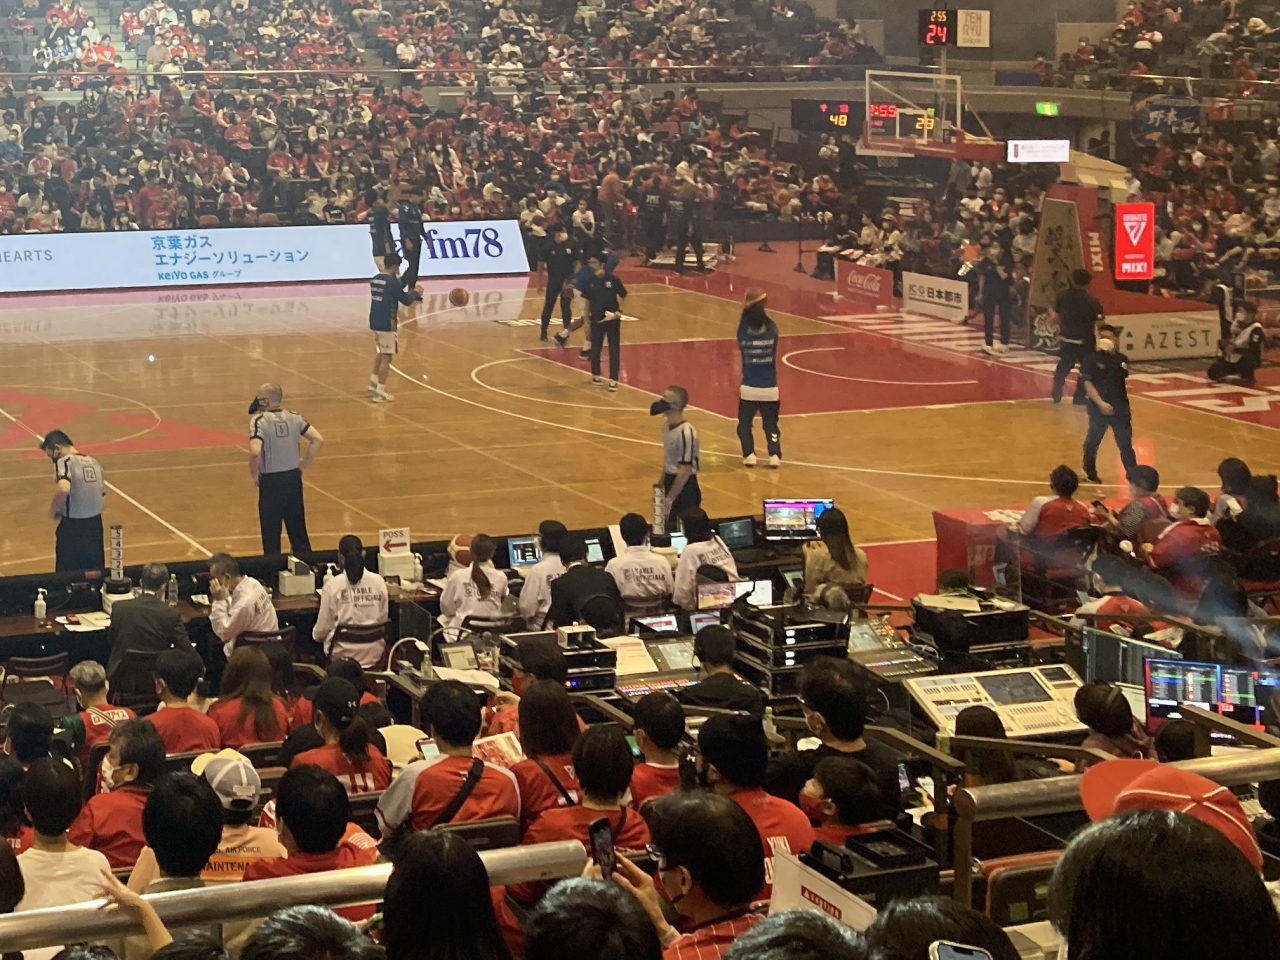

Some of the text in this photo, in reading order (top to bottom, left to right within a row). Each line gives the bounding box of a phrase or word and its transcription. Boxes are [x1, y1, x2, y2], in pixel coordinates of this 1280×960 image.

[926, 24, 947, 44] 24
[830, 114, 848, 127] 48
[151, 235, 212, 250] 京葉ガス
[155, 249, 310, 266] エナジーソリューション
[190, 271, 209, 280] GAS
[1144, 329, 1212, 349] AZEST
